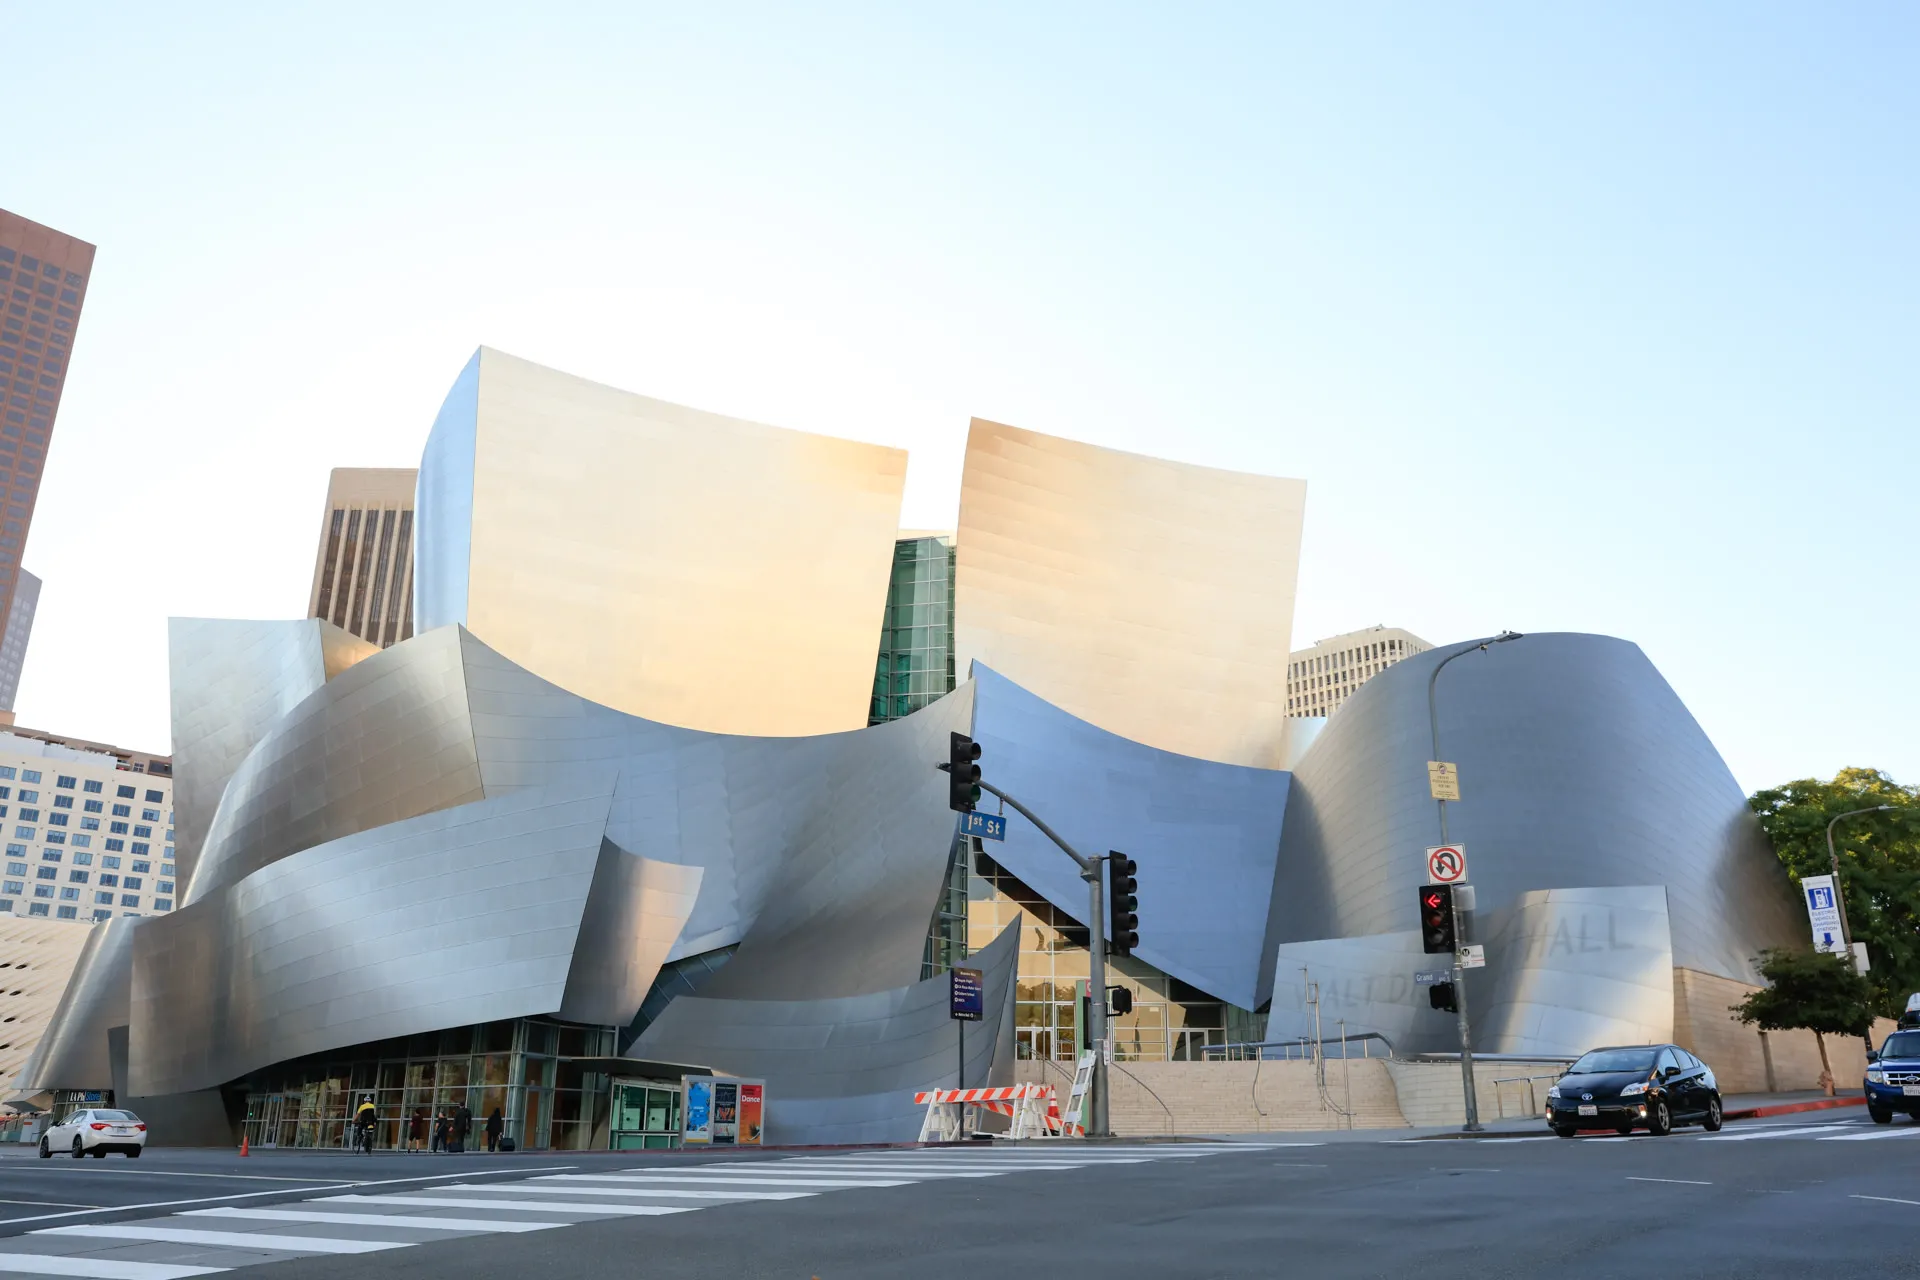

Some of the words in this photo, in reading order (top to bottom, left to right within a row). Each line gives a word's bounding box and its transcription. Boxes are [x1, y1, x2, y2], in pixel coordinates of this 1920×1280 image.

[968, 814, 983, 831] 1st
[986, 819, 1000, 835] St
[1416, 974, 1433, 982] Grand
[86, 1091, 101, 1101] Store
